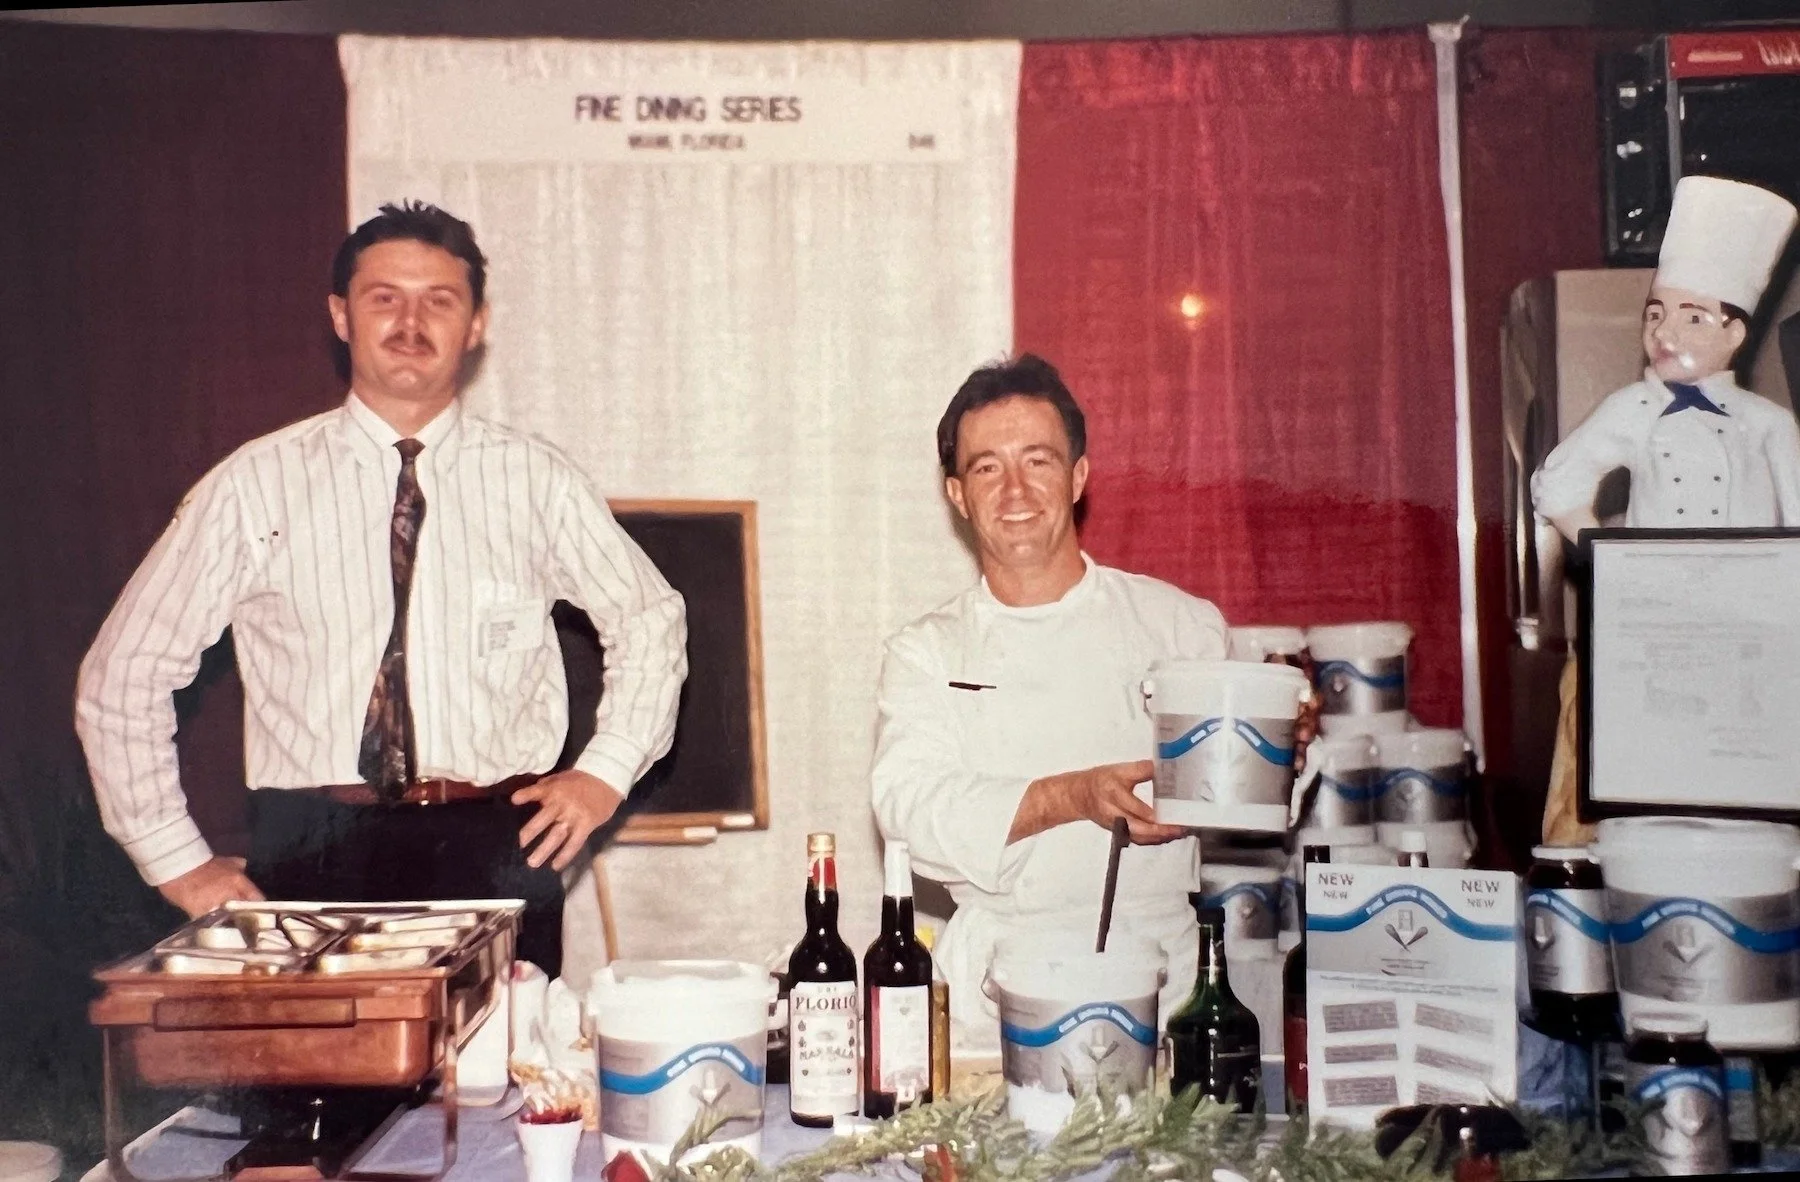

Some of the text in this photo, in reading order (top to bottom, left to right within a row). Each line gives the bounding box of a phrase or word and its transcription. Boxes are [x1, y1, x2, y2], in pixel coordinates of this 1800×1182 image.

[575, 94, 803, 122] FINE DINING SERIES
[1318, 873, 1354, 886] NEW
[1461, 880, 1500, 893] NEW
[1323, 889, 1348, 900] NEW
[1467, 898, 1495, 909] NEW
[796, 996, 857, 1010] FLORIO
